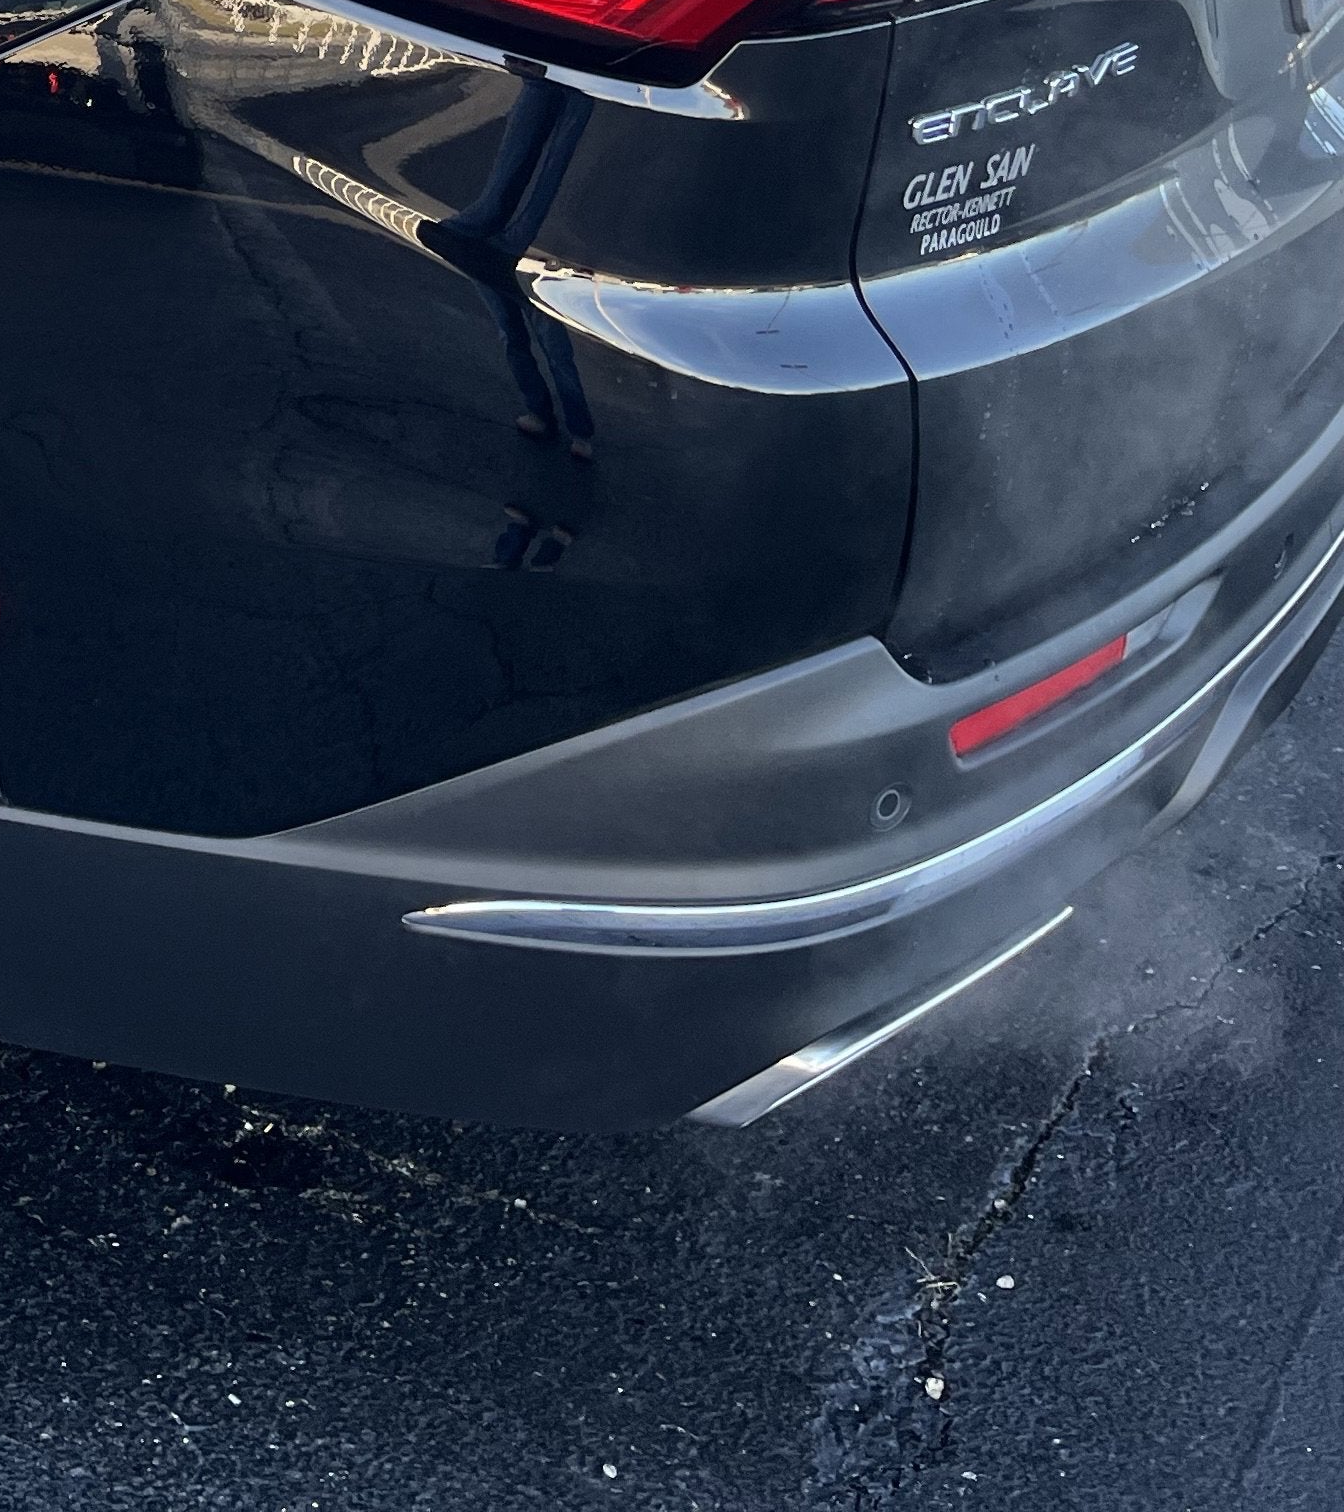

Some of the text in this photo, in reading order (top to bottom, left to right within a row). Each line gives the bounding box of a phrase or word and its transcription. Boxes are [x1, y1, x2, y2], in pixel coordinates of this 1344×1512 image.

[908, 42, 1139, 145] ENCLAVE
[903, 161, 974, 210] GLEN
[910, 186, 1016, 233] RECTOR-KENNETT
[920, 214, 1001, 255] PARAGOULD
